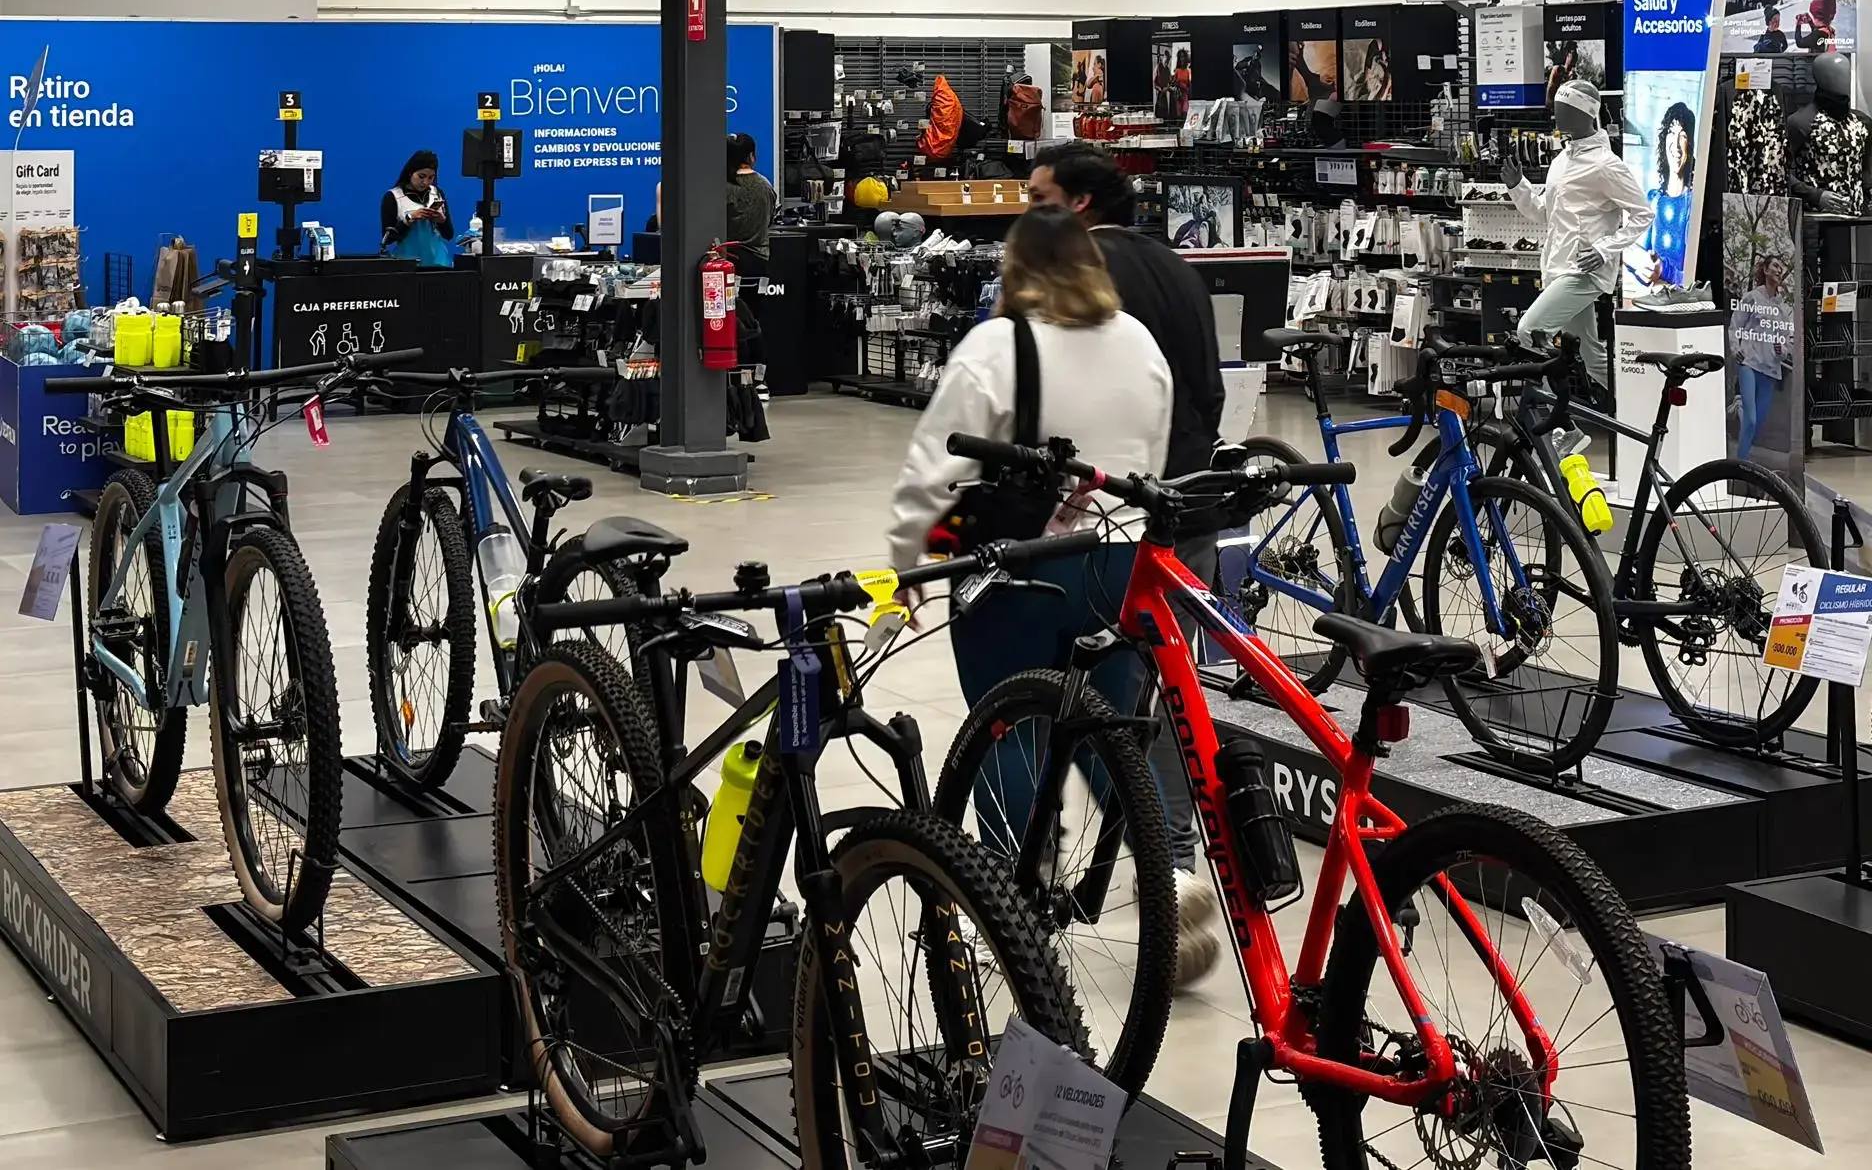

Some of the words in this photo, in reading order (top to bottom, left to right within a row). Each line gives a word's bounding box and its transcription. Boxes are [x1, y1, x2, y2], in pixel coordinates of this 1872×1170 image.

[1161, 21, 1179, 30] FITNESS
[1555, 15, 1573, 23] Lentes
[1573, 15, 1587, 24] para
[1633, 16, 1703, 34] Accesorios
[533, 64, 565, 74] ¡HOLA!
[285, 94, 294, 106] 3
[484, 95, 493, 107] 2
[511, 79, 738, 116] Bienvens
[51, 103, 134, 128] tienda
[534, 127, 617, 138] INFORMACIONES
[534, 143, 581, 153] CAMBIOS
[583, 143, 590, 152] Y
[592, 142, 661, 152] DEVOLUCIONE
[534, 158, 571, 168] RETIRO
[573, 157, 618, 167] EXPRESS
[620, 157, 633, 166] EN
[636, 157, 641, 166] 1
[644, 156, 661, 166] HO
[16, 164, 34, 178] Gift
[36, 163, 59, 178] Card
[494, 281, 519, 291] CAJA
[765, 283, 785, 296] ON
[293, 303, 320, 312] CAJA
[322, 299, 400, 311] PREFERENCIAL
[1730, 298, 1739, 310] El
[1740, 302, 1779, 316] invierno
[1760, 318, 1771, 328] es
[1772, 320, 1795, 331] para
[1734, 328, 1786, 345] disfrutarlo
[42, 415, 96, 436] Rea
[59, 441, 77, 455] to
[1390, 529, 1413, 564] VAN
[1407, 480, 1440, 530] RYSEL
[1835, 583, 1867, 595] REGULAR
[1819, 601, 1849, 610] CICLISMO
[1273, 761, 1338, 826] RYS
[1162, 685, 1251, 949] ROCKRIDER
[3, 868, 92, 1016] ROCKRIDER
[935, 901, 984, 1057] MANITO
[824, 920, 877, 1106] MANITOU
[1054, 1084, 1063, 1100] 12
[1062, 1086, 1106, 1109] VELOCIDADES
